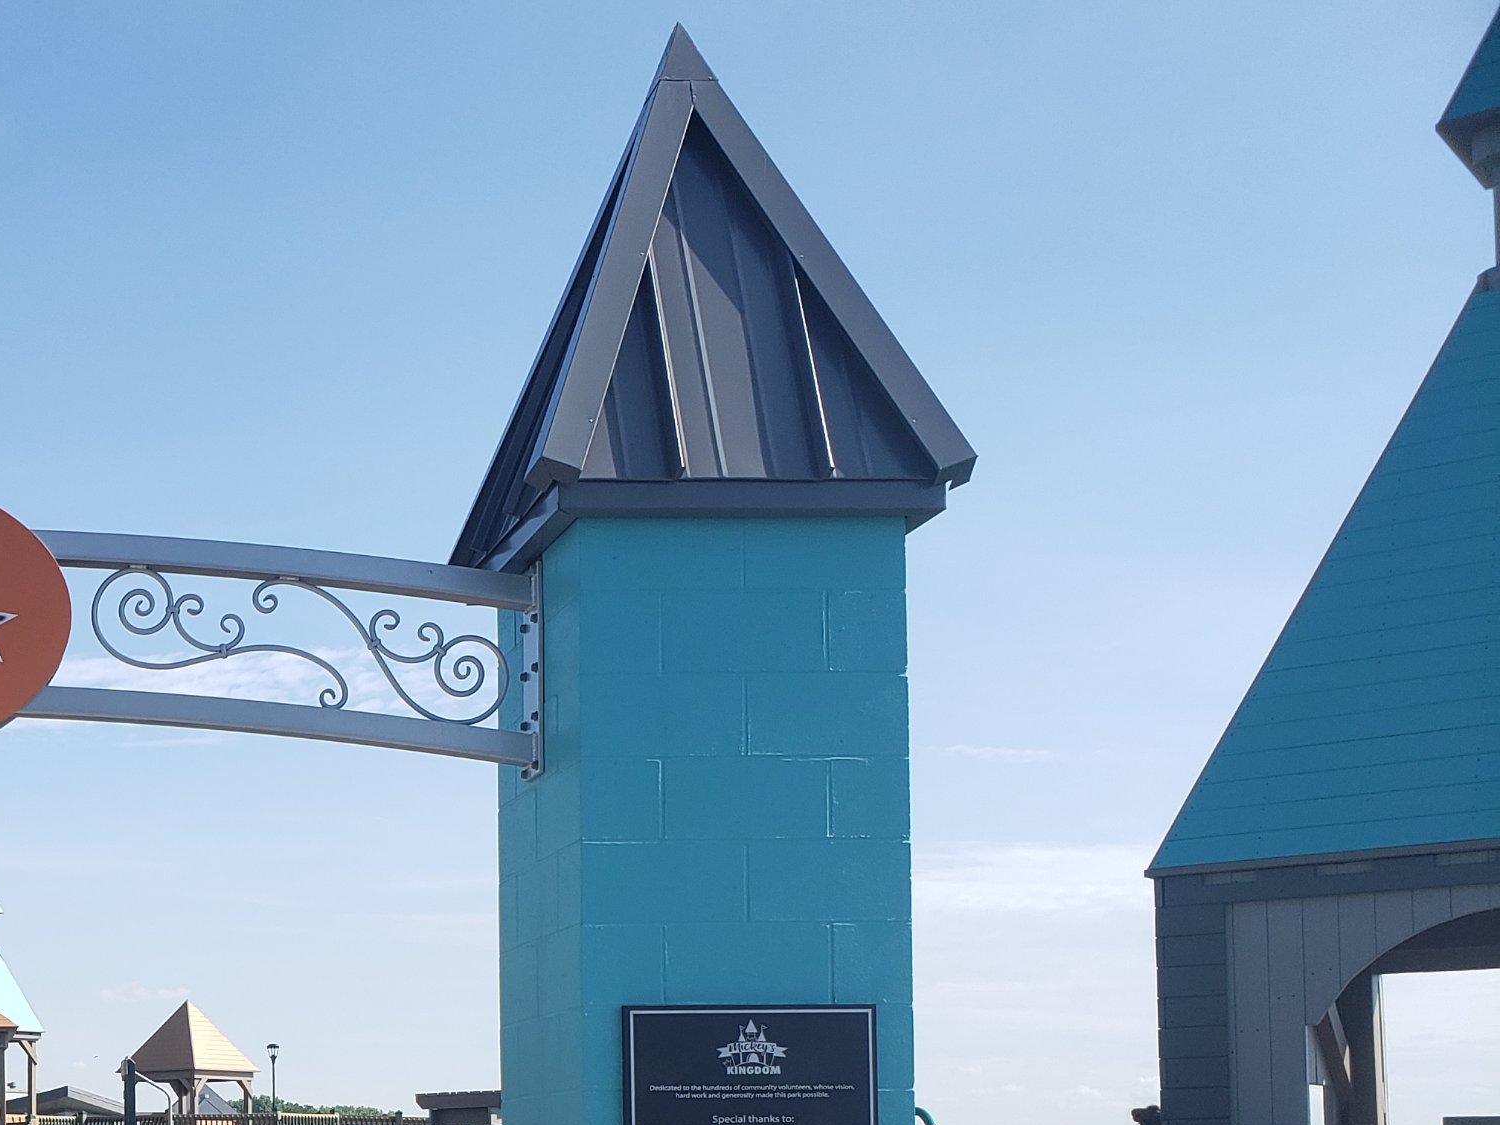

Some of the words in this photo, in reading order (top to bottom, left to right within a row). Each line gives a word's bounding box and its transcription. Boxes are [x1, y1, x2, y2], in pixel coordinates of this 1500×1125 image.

[728, 1040, 775, 1055] Mickey's
[726, 1066, 781, 1075] KINGDOM
[712, 1115, 746, 1125] Special
[748, 1115, 780, 1123] thanks
